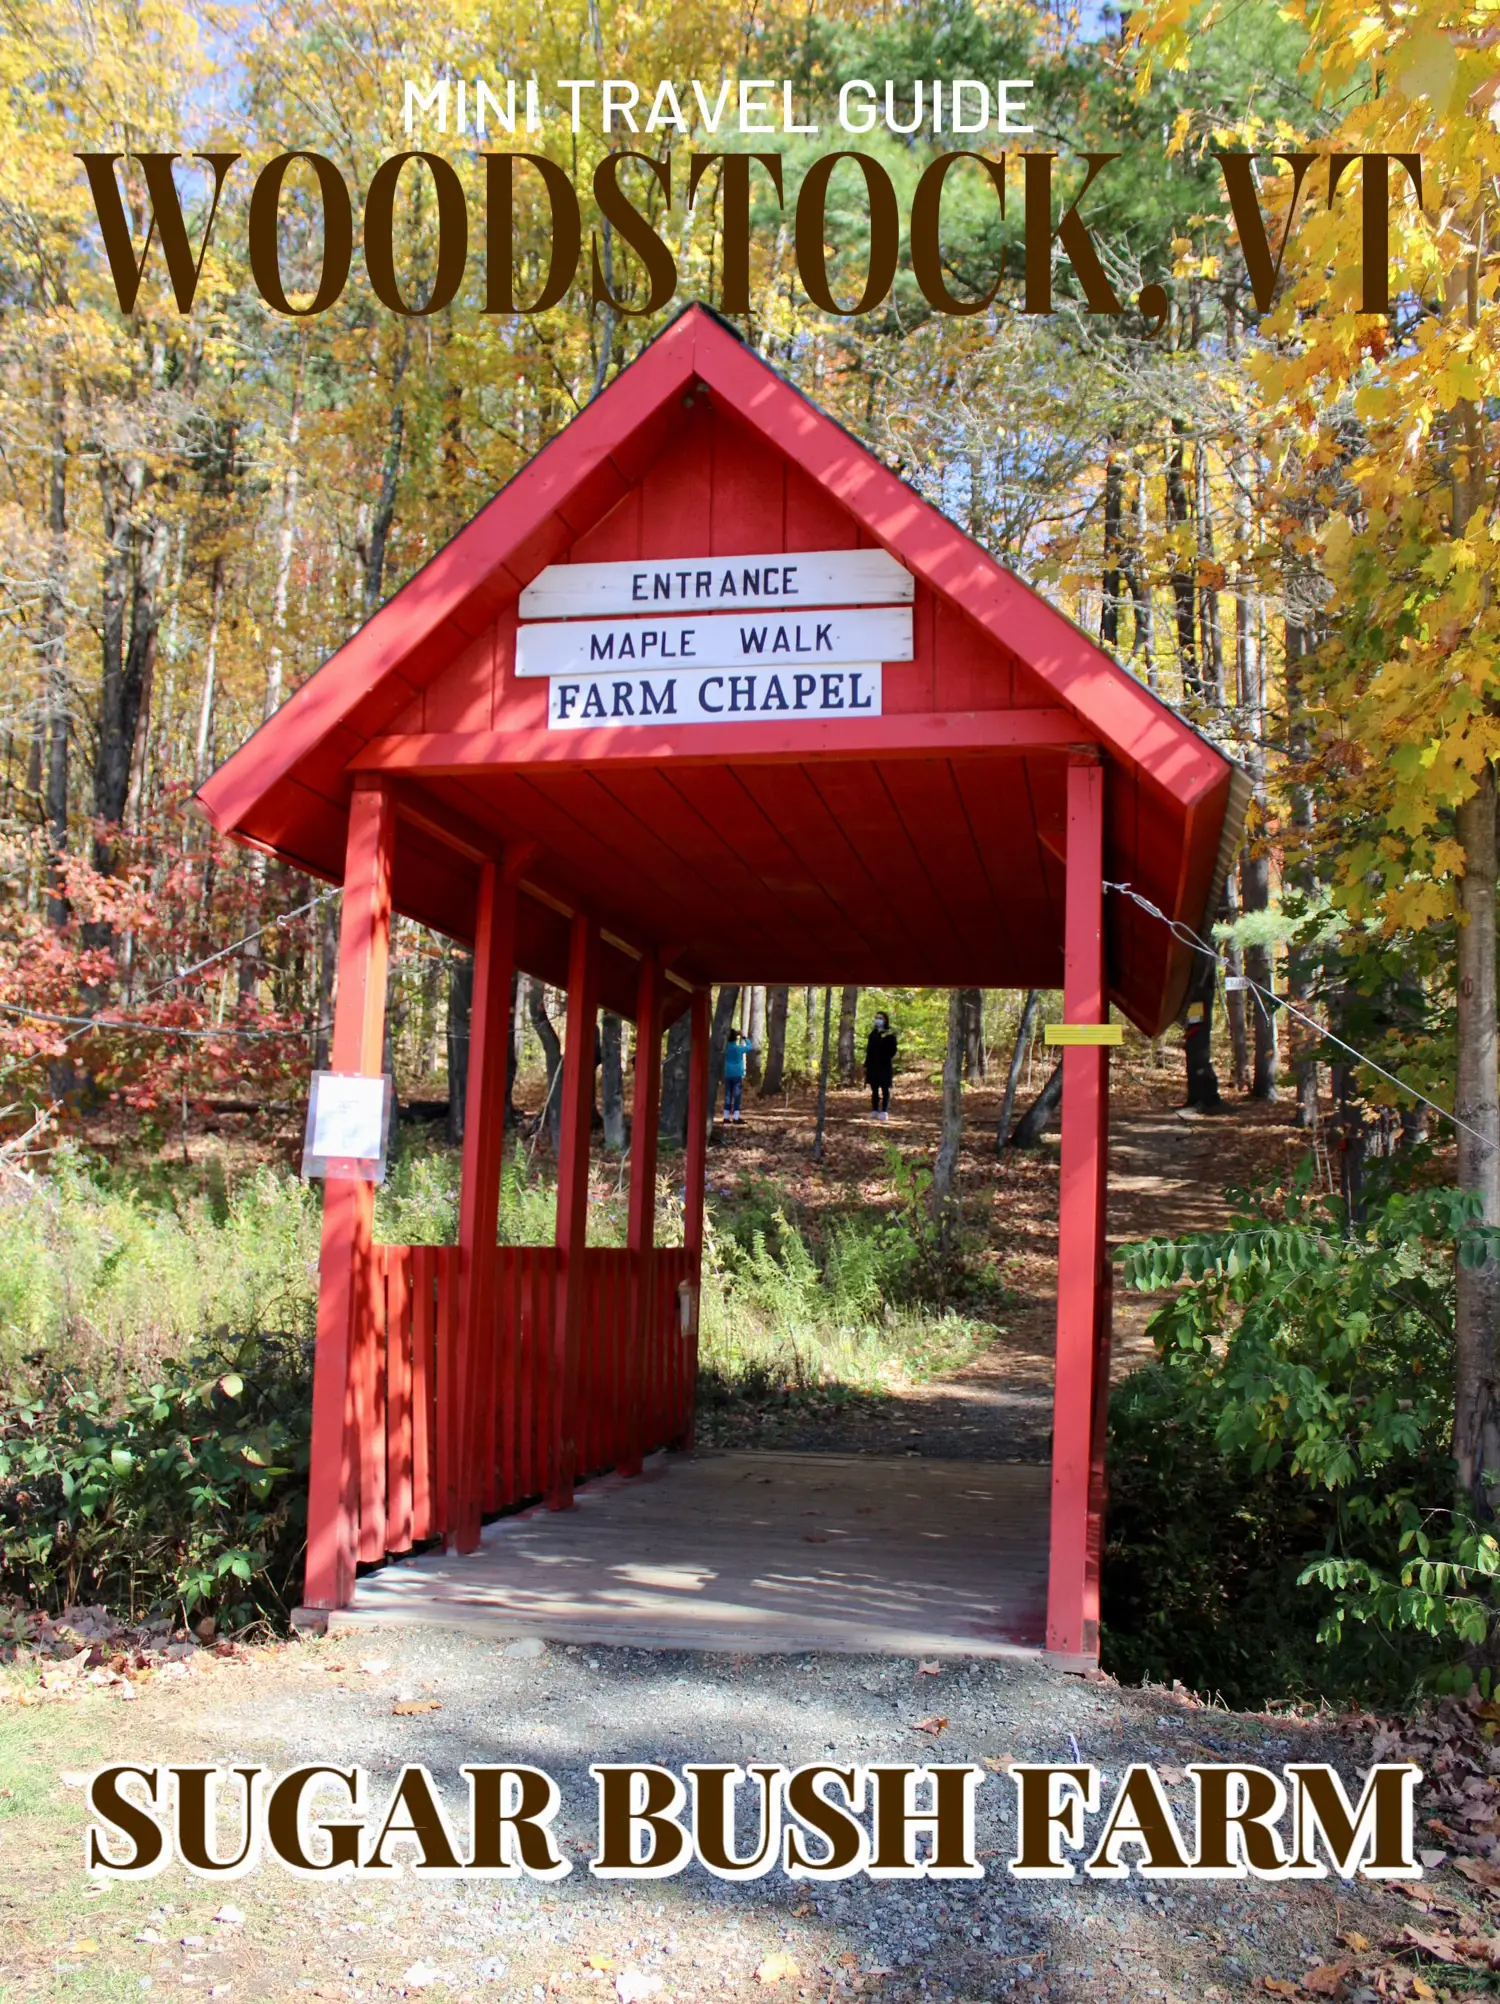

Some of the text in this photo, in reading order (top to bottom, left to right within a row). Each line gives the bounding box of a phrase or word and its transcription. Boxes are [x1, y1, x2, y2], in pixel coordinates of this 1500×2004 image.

[632, 566, 799, 601] ENTRANCE
[589, 623, 834, 661] MAPLE WALK
[556, 672, 872, 720] FARM CHAPEL
